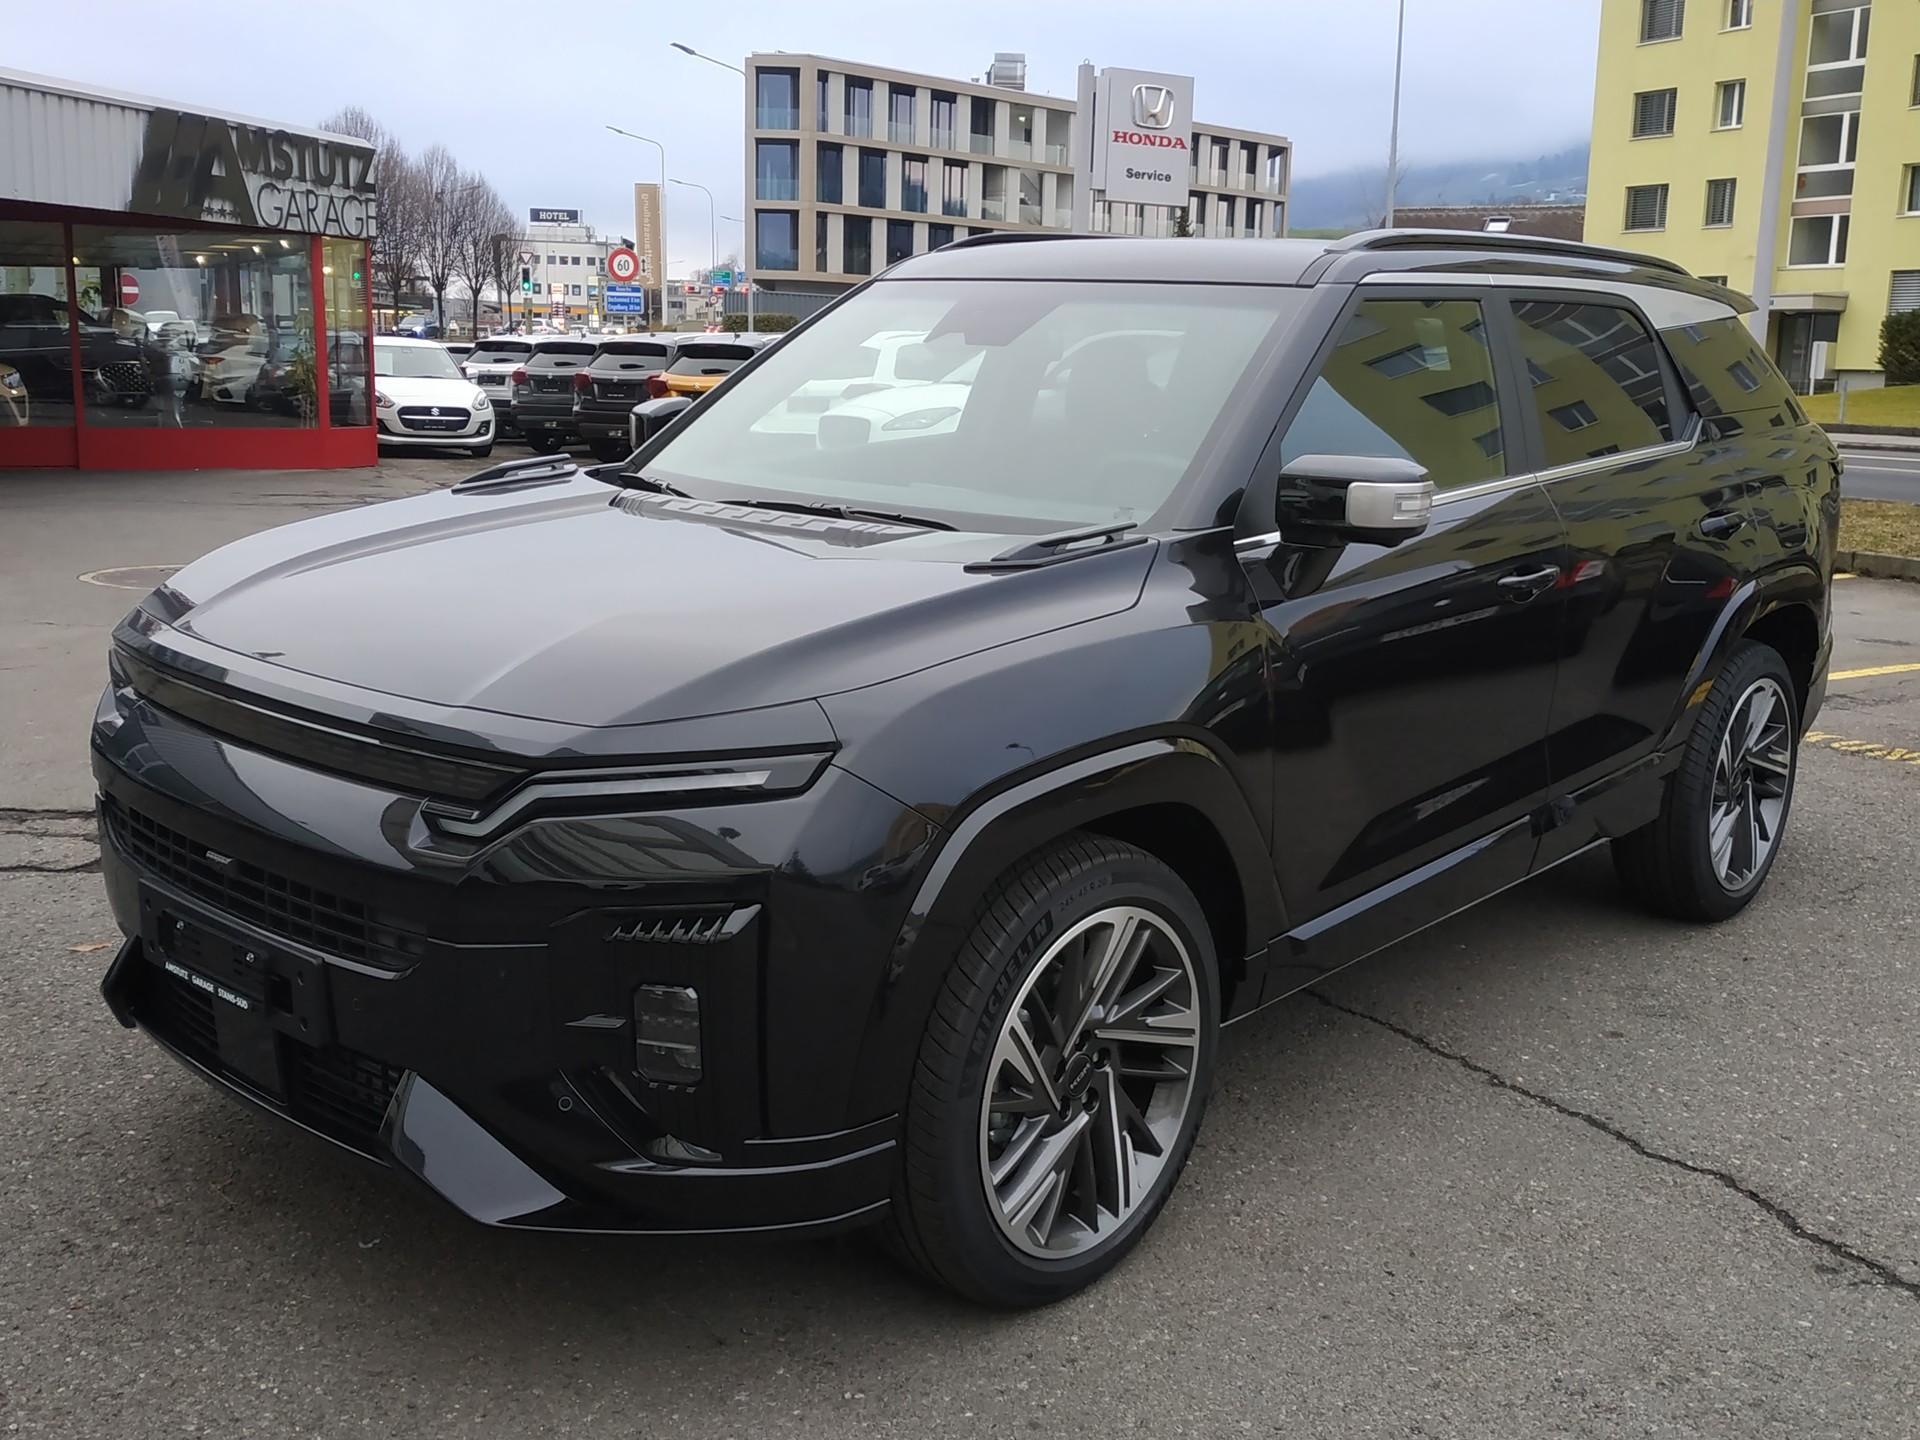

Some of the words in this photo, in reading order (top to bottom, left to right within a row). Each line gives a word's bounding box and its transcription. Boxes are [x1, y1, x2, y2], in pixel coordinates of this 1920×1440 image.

[1112, 130, 1188, 150] HONDA
[180, 115, 377, 226] AMSTUTZ
[1125, 167, 1172, 183] Service
[257, 182, 377, 239] GARAGE
[539, 211, 570, 221] HOTEL
[617, 259, 630, 271] 60
[165, 961, 189, 980] AMSTUTZ
[191, 975, 215, 993] GARAGE
[971, 916, 1050, 1054] MICHELIN
[1070, 1062, 1091, 1089] KGM
